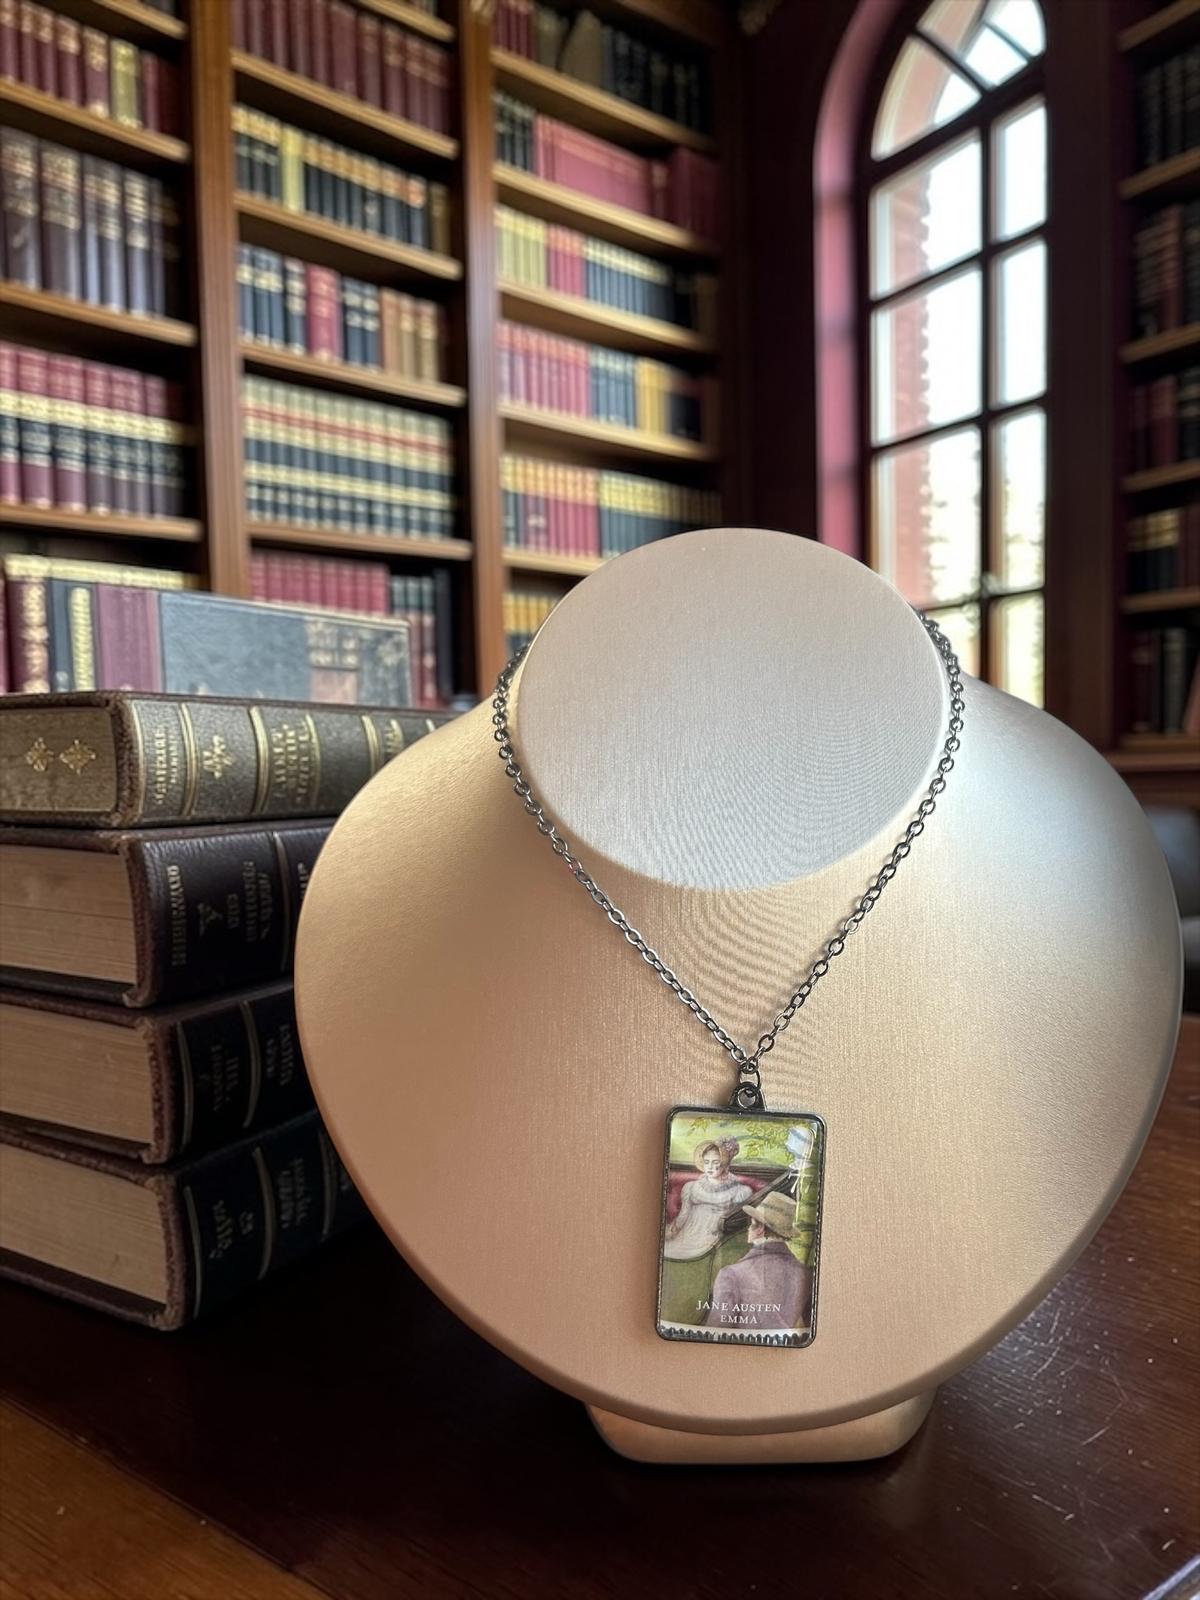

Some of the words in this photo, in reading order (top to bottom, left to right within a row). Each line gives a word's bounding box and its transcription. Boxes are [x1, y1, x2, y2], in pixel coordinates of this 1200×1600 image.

[696, 1300, 729, 1311] JANE
[732, 1302, 782, 1313] AUSTEN
[720, 1314, 759, 1325] EMMA
